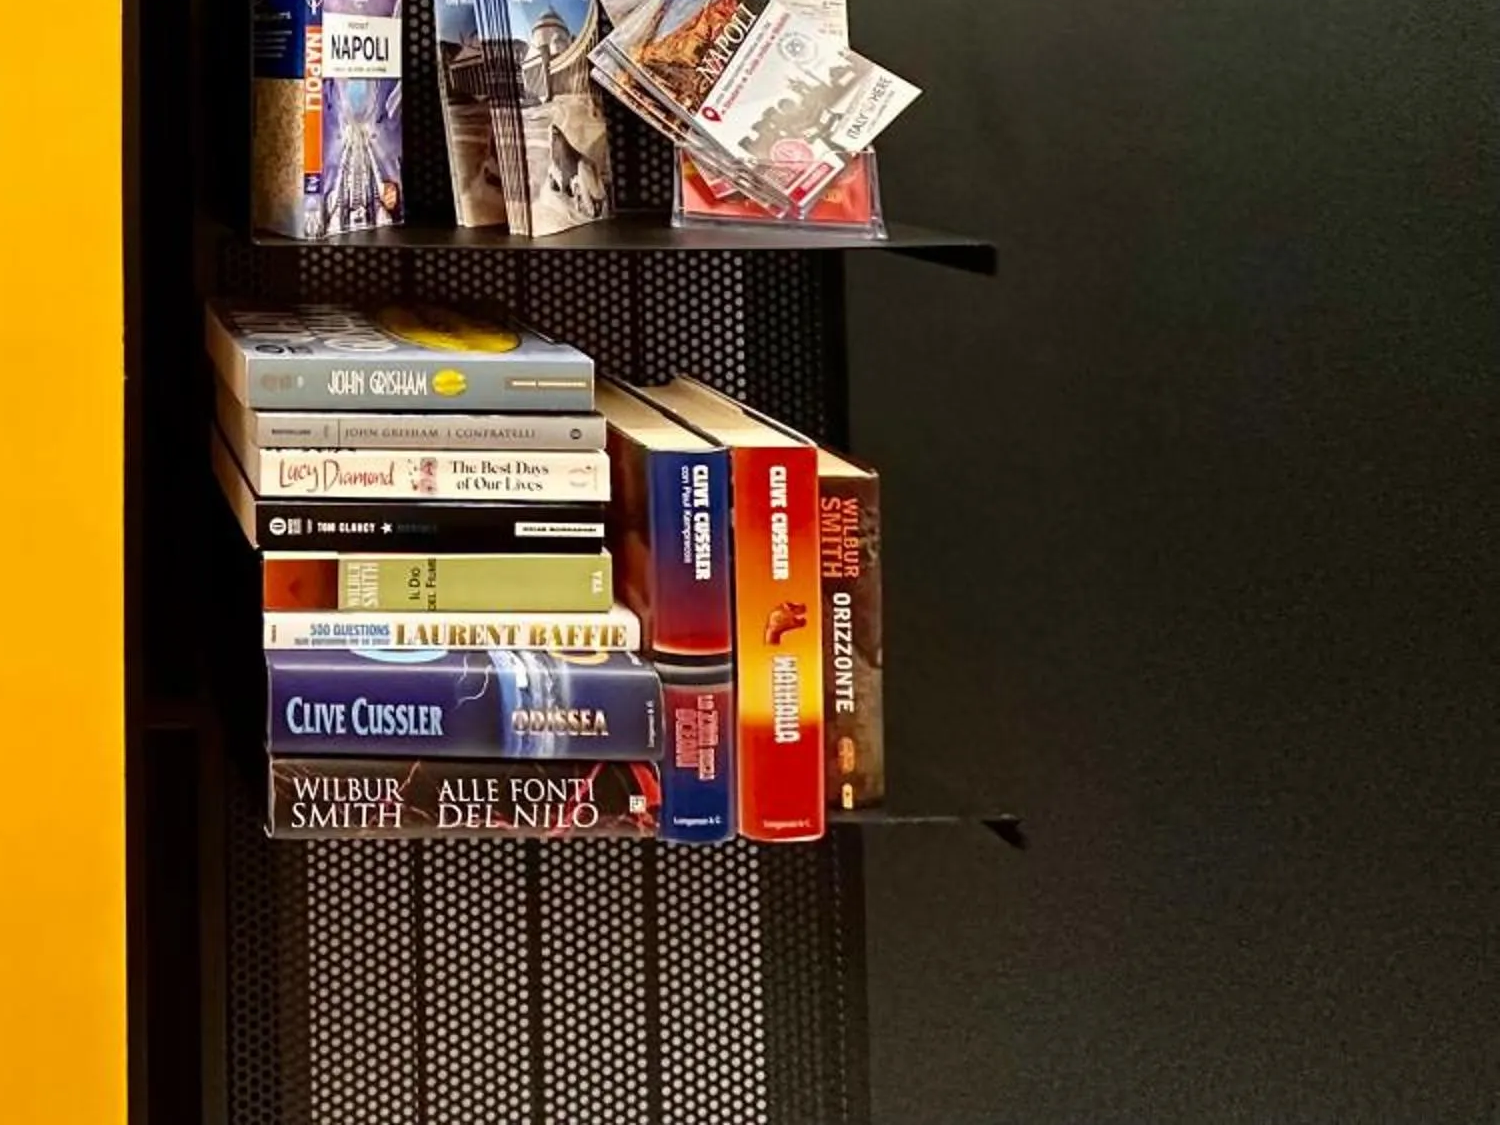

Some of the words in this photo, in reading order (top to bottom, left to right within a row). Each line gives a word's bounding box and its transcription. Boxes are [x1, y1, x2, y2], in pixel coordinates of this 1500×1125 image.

[330, 34, 389, 62] NAPOLI
[696, 2, 757, 85] NAPOLI
[306, 31, 323, 110] NAPOLI
[327, 370, 365, 395] JOHN
[369, 369, 428, 397] GRISHAM
[344, 428, 378, 438] JOHN
[382, 428, 439, 438] GRISHAM
[455, 430, 536, 438] CONFRATELLI
[279, 458, 319, 492] Lucy
[323, 459, 395, 492] Diamond
[450, 461, 476, 475] The
[481, 461, 511, 475] Best
[516, 461, 549, 476] Days
[681, 465, 689, 484] con
[456, 476, 471, 491] of
[474, 477, 502, 491] Our
[505, 476, 543, 491] Lives
[682, 486, 692, 508] Paul
[693, 464, 709, 508] CLIVE
[769, 465, 788, 508] CLIVE
[317, 521, 336, 532] TOM
[339, 521, 376, 532] CLANCY
[820, 497, 843, 579] SMITH
[842, 498, 859, 578] WILBUR
[694, 512, 711, 580] CUSSLER
[771, 512, 789, 580] CUSSLER
[362, 562, 379, 608] SMITH
[408, 567, 421, 588] DIO
[310, 623, 331, 636] 500
[333, 623, 390, 636] QUESTIONS
[395, 624, 520, 646] LAURENT
[528, 624, 627, 647] BAFFIE
[833, 592, 854, 713] ORIZZONTE
[773, 655, 800, 744] WALHALLA
[286, 696, 346, 736] CLIVE
[351, 698, 444, 736] CUSSLER
[511, 709, 609, 736] ODISSEA
[293, 777, 404, 802] WILBUR
[438, 777, 499, 802] ALLE
[511, 777, 596, 802] FONTI
[291, 802, 401, 829] SMITH
[438, 802, 502, 829] DEL
[513, 802, 599, 829] NILO
